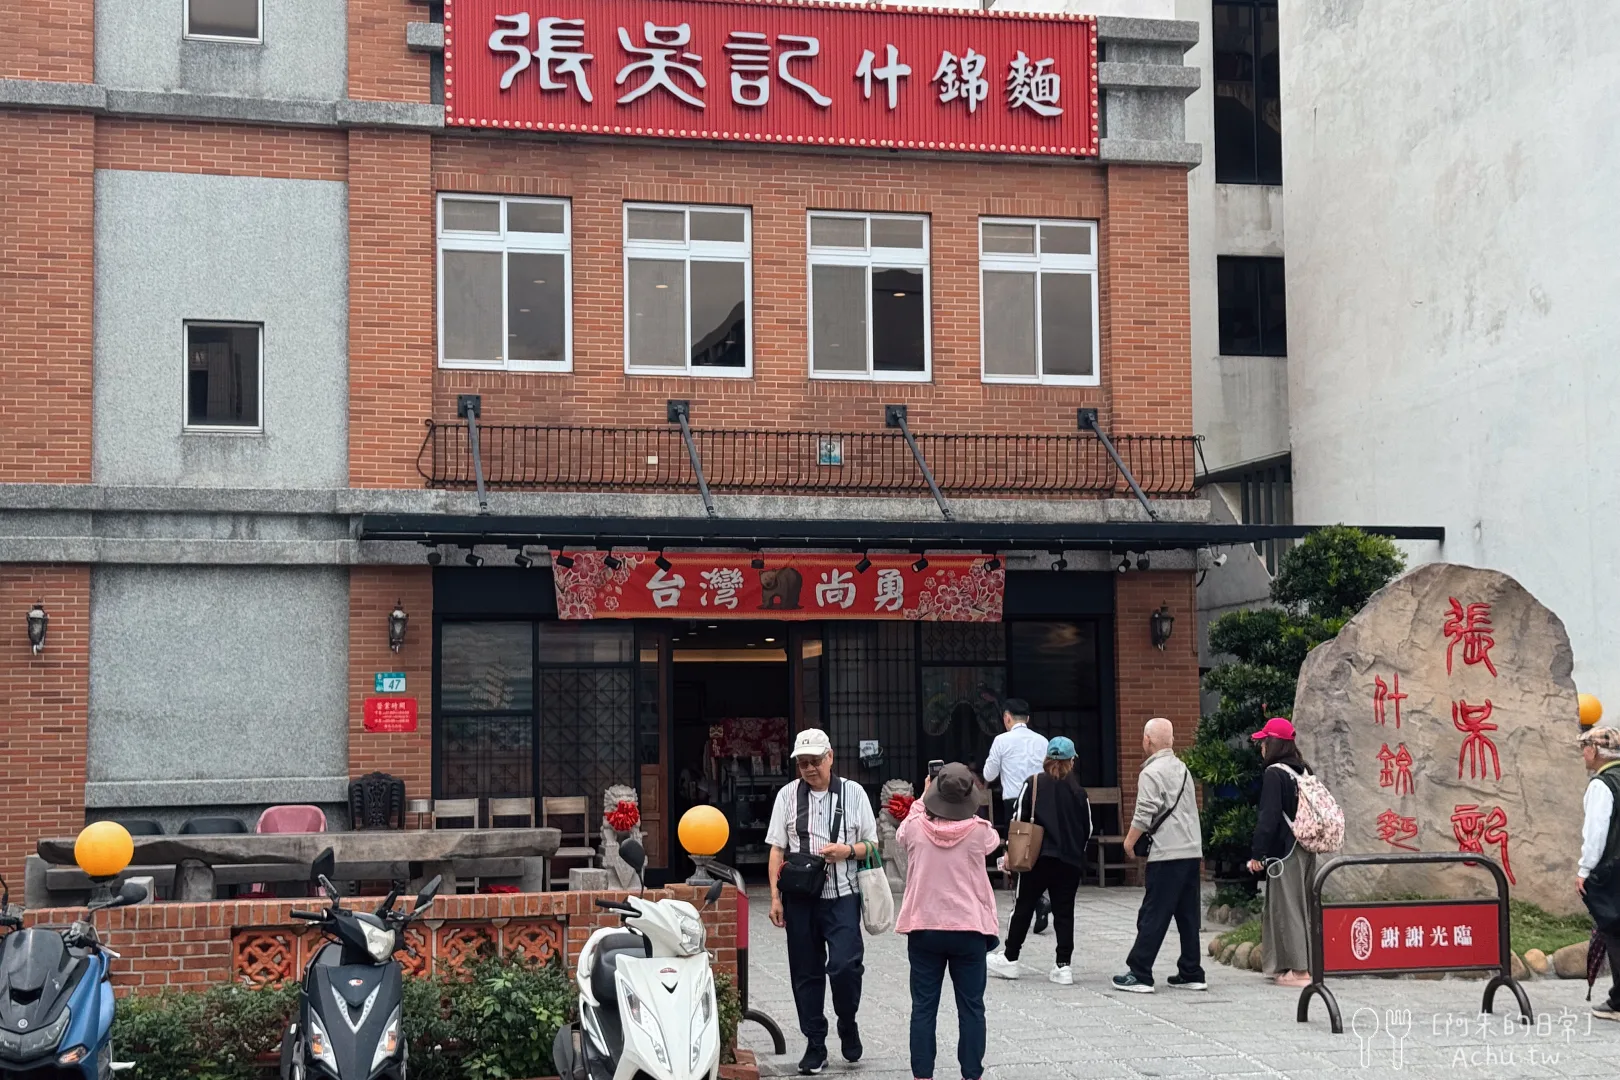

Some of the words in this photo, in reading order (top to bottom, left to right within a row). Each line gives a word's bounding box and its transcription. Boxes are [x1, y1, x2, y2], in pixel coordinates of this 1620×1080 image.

[645, 568, 744, 610] 台灣
[815, 568, 905, 612] 尚勇
[388, 679, 402, 690] 47
[1380, 924, 1473, 949] 謝謝光臨
